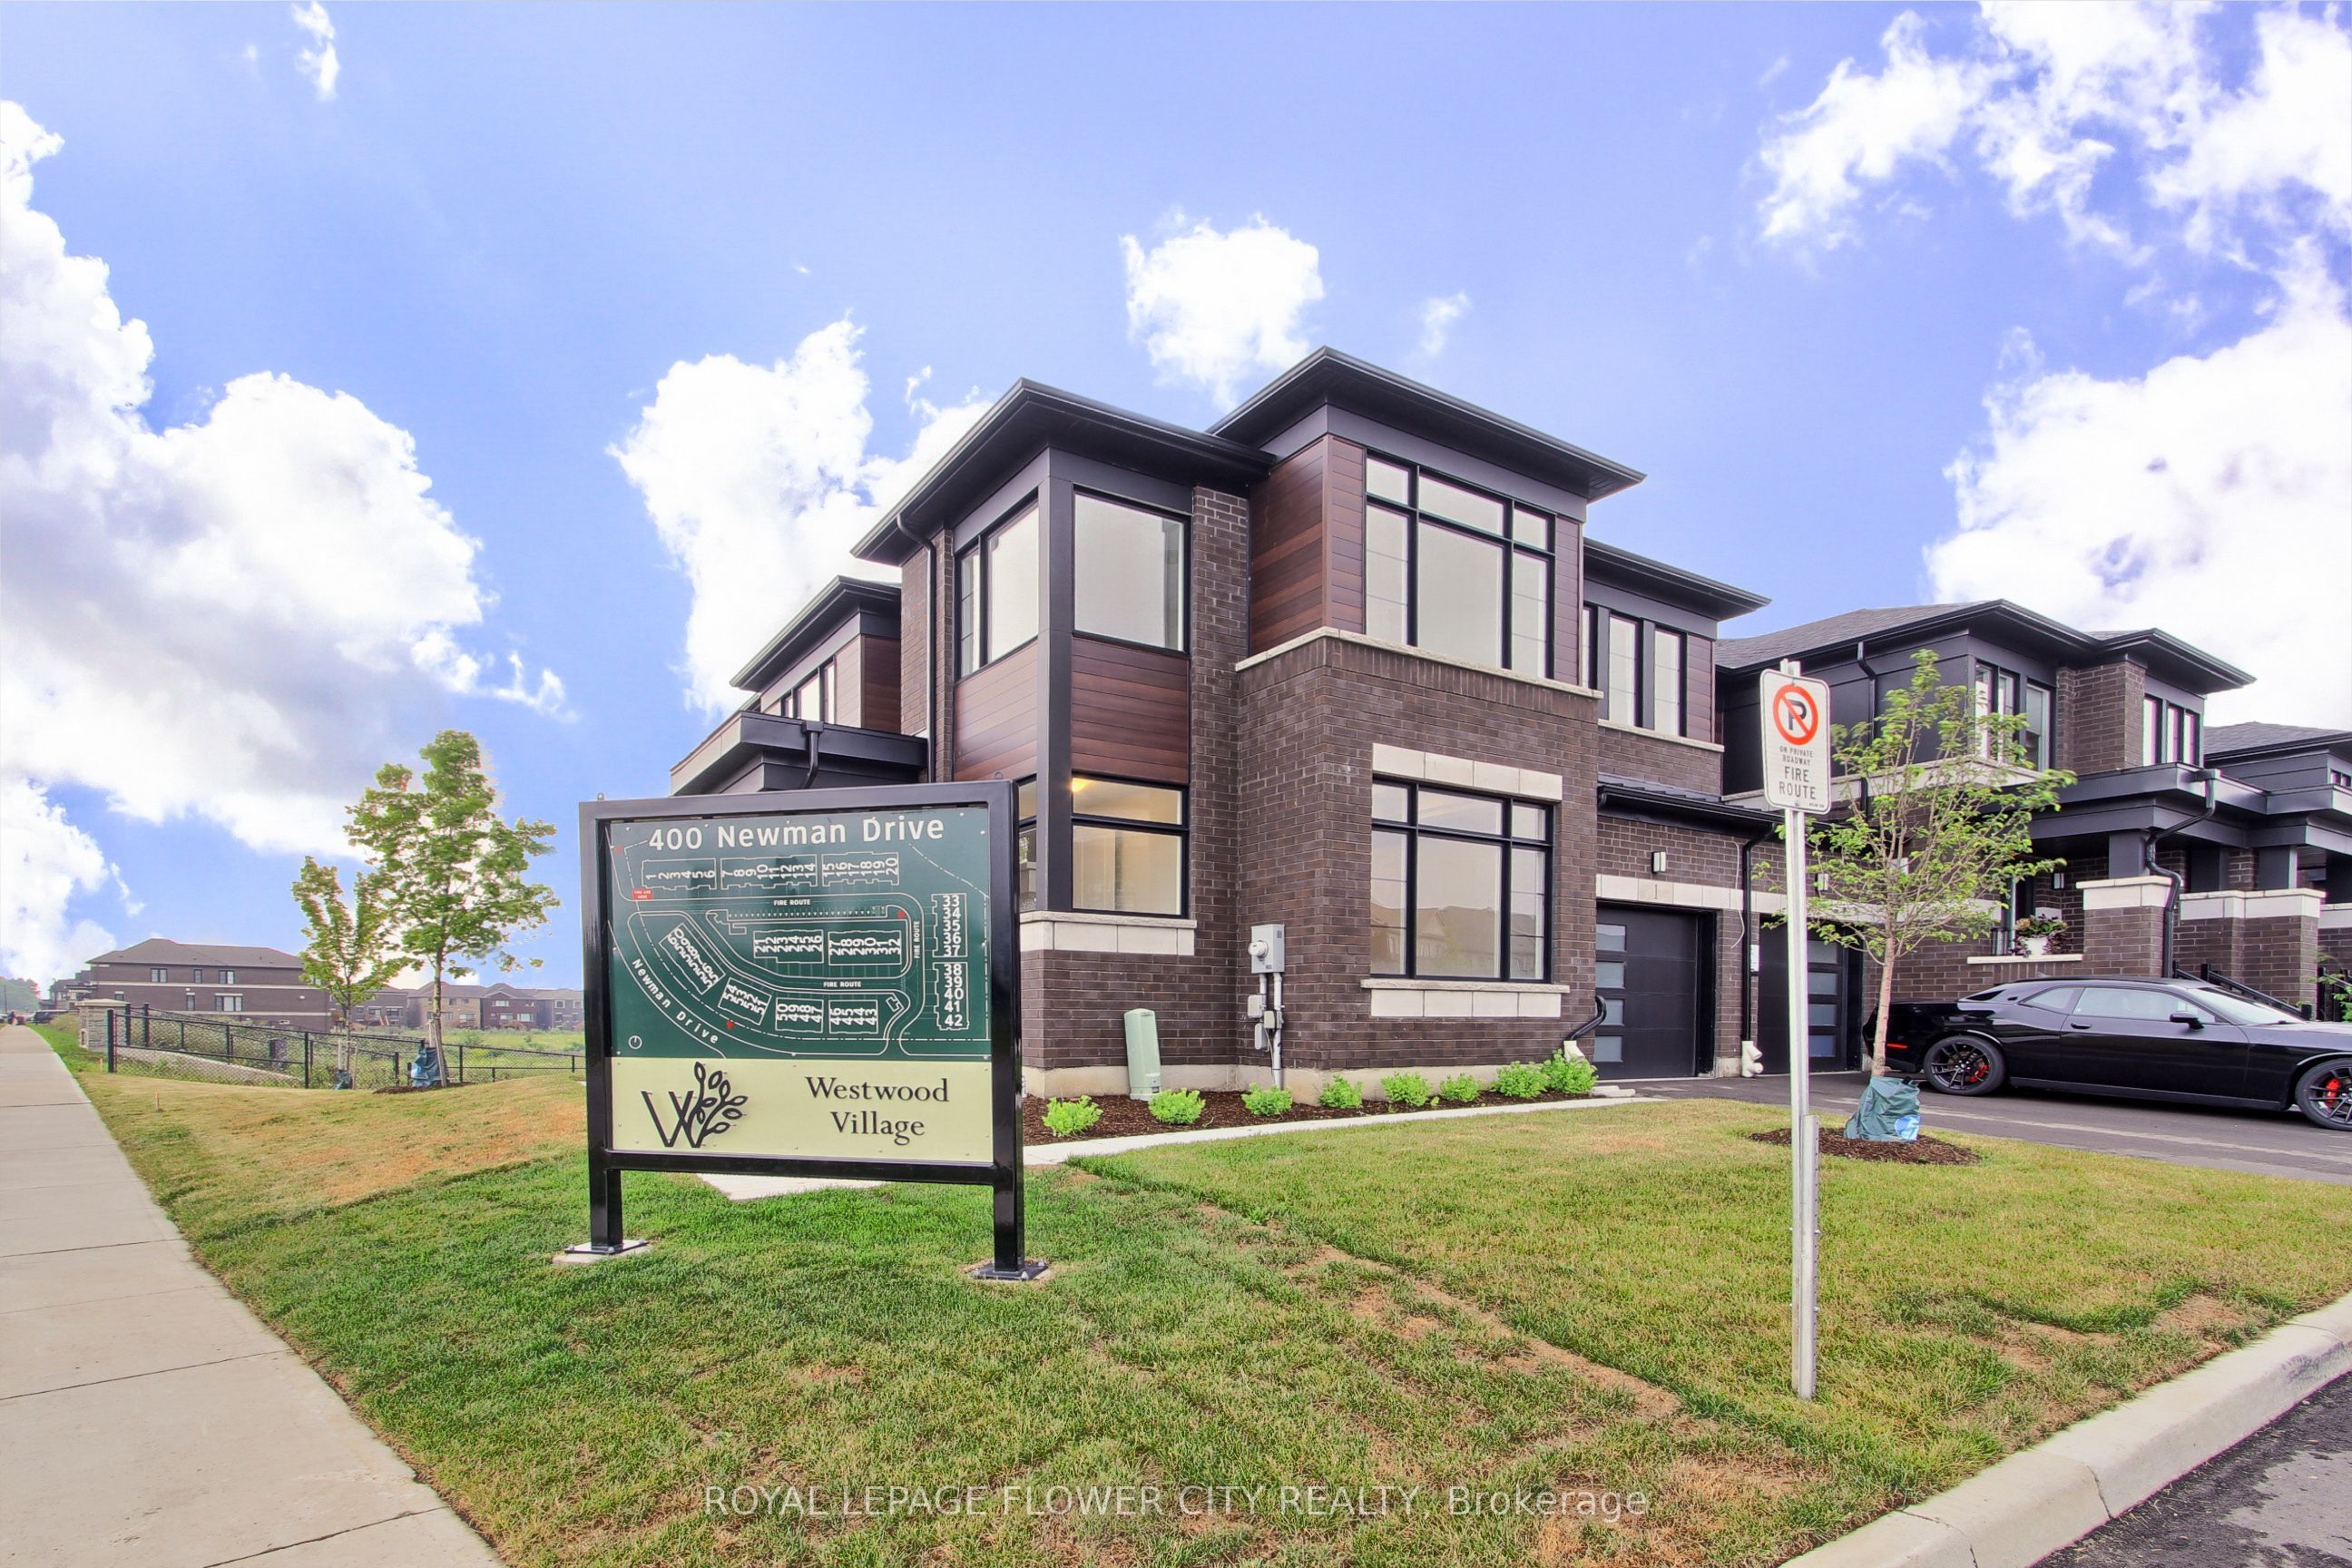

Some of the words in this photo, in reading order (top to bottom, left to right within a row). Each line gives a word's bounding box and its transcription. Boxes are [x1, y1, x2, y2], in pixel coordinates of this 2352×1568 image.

[1782, 754, 1811, 767] ROADWAY
[1789, 747, 1813, 758] PRIVATE
[1785, 766, 1809, 783] FIRE
[1779, 781, 1817, 800] ROUTE
[649, 828, 702, 851] 400
[718, 824, 846, 848] Newman
[863, 816, 945, 842] Drive
[757, 864, 768, 879] 10
[769, 867, 779, 879] 11
[780, 865, 792, 878] 12
[792, 864, 804, 878] 13
[804, 863, 816, 878] 14
[823, 863, 835, 877] 15
[836, 862, 848, 877] 16
[848, 863, 859, 877] 17
[860, 861, 872, 877] 18
[873, 860, 885, 876] 19
[886, 858, 897, 876] 20
[943, 895, 960, 907] 33
[943, 907, 961, 919] 34
[943, 919, 961, 932] 35
[755, 939, 766, 952] 21
[766, 936, 777, 952] 22
[777, 936, 789, 952] 23
[789, 936, 799, 952] 24
[799, 936, 811, 952] 25
[810, 935, 822, 952] 26
[864, 937, 877, 956] 30
[943, 932, 962, 945] 36
[829, 940, 841, 956] 27
[840, 938, 852, 956] 28
[852, 938, 864, 956] 29
[877, 940, 888, 956] 31
[888, 938, 901, 956] 32
[944, 946, 961, 957] 37
[944, 964, 962, 975] 38
[944, 976, 963, 988] 39
[632, 958, 671, 1008] Newman
[676, 1011, 719, 1044] Drive
[945, 988, 964, 1000] 40
[777, 1004, 789, 1021] 50
[788, 1004, 799, 1022] 49
[799, 1004, 811, 1023] 48
[810, 1006, 822, 1023] 47
[945, 1001, 961, 1013] 41
[830, 1008, 841, 1025] 46
[841, 1008, 853, 1025] 45
[853, 1007, 865, 1025] 44
[865, 1008, 877, 1025] 43
[945, 1014, 963, 1026] 42
[806, 1077, 948, 1102] Westwood
[830, 1111, 926, 1145] Village
